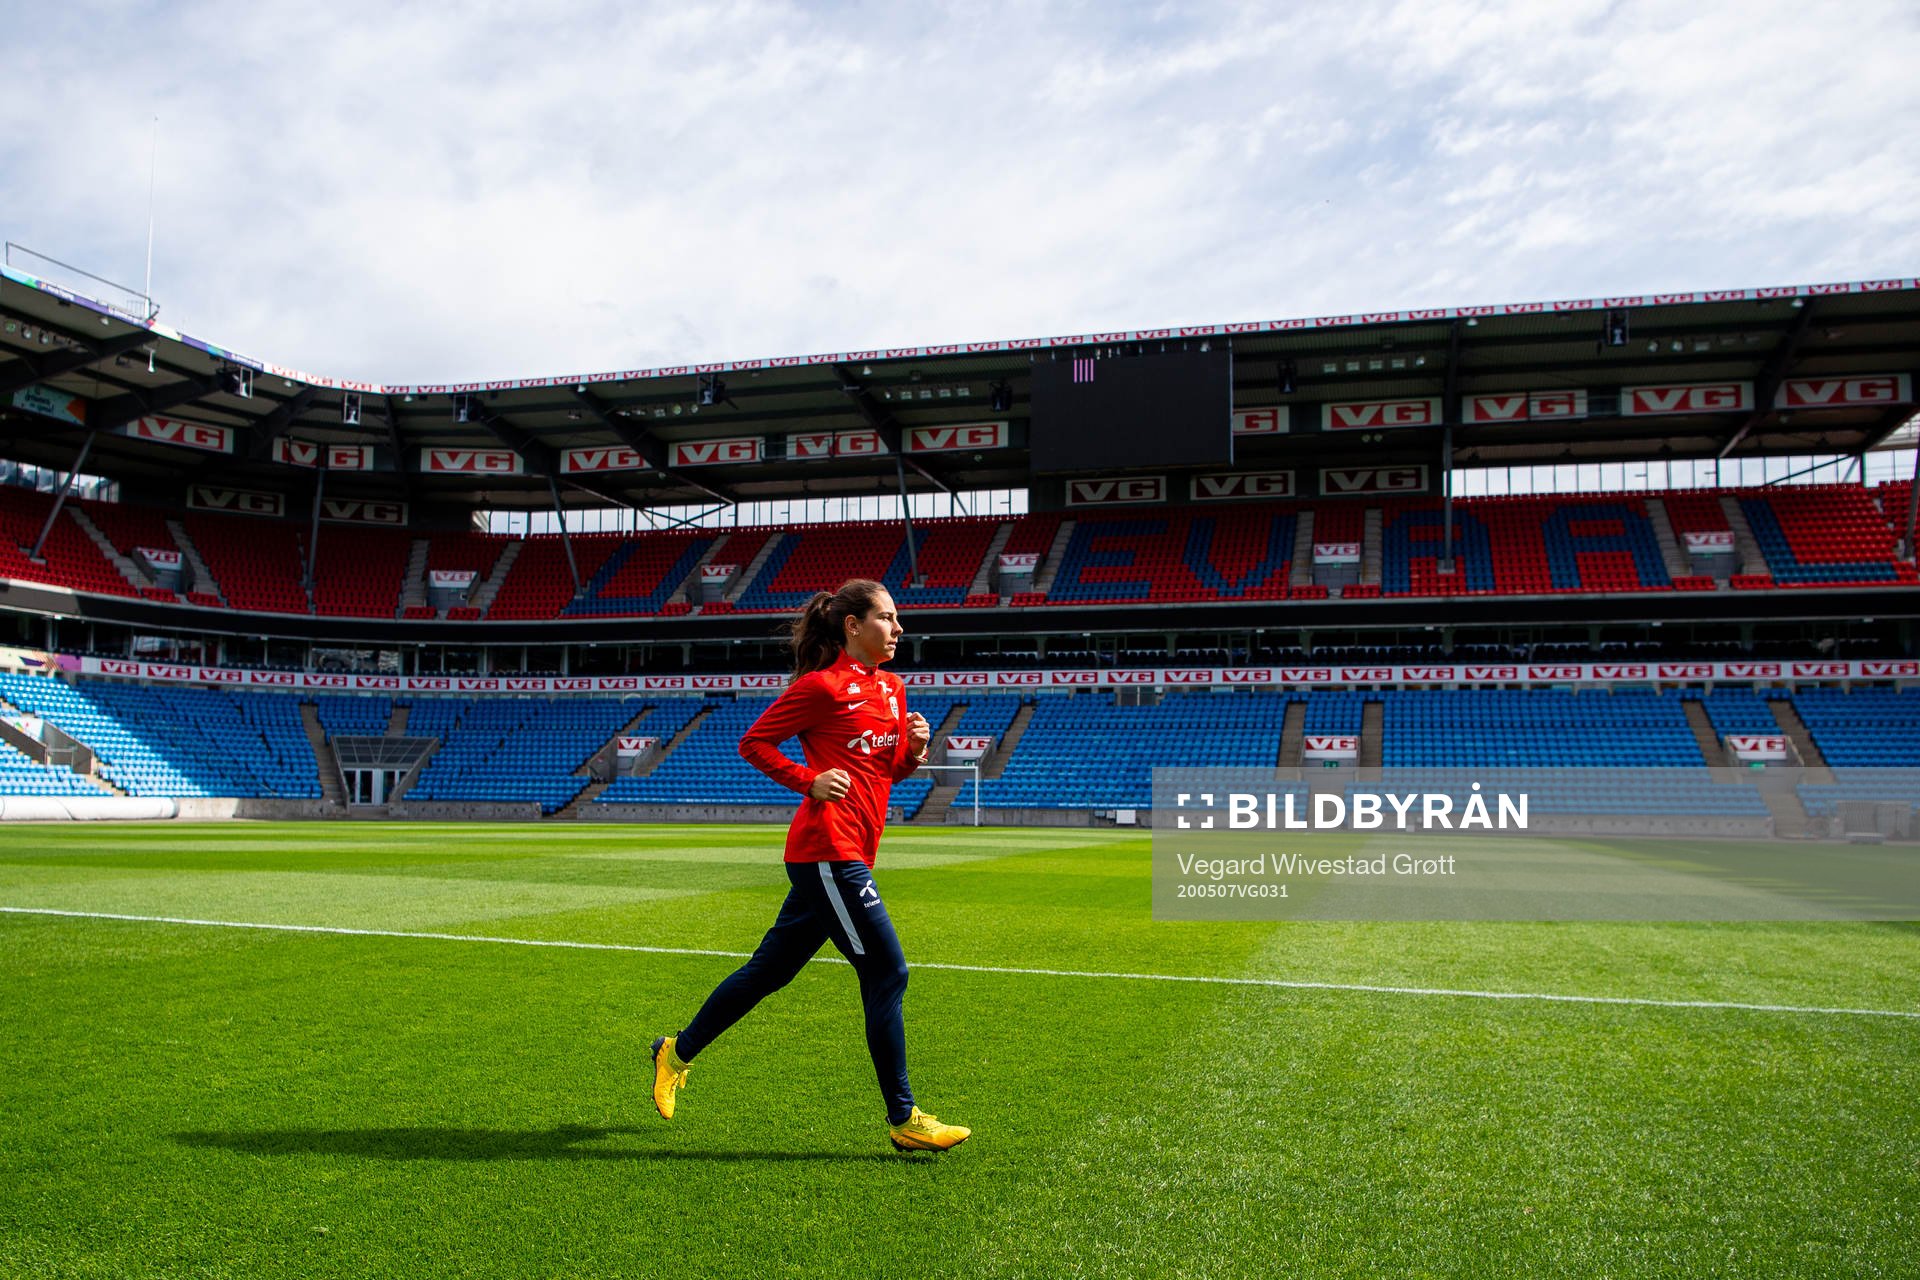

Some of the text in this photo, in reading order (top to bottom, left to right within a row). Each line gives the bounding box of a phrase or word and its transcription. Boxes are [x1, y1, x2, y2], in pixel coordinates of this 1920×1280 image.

[343, 380, 371, 391] VG
[384, 386, 408, 394] VG
[419, 386, 445, 394] VG
[455, 384, 477, 392] VG
[487, 382, 511, 390] VG
[521, 379, 545, 387] VG
[555, 376, 580, 384] VG
[590, 373, 615, 381] VG
[625, 371, 650, 379] VG
[660, 366, 686, 376] VG
[697, 364, 723, 373] VG
[734, 360, 761, 369] VG
[772, 357, 798, 366] VG
[809, 354, 837, 363] VG
[848, 351, 876, 360] VG
[887, 349, 916, 358] VG
[928, 346, 957, 355] VG
[968, 343, 999, 352] VG
[1009, 340, 1040, 349] VG
[1051, 337, 1083, 346] VG
[1095, 333, 1125, 342] VG
[1137, 330, 1170, 339] VG
[1181, 327, 1214, 336] VG
[1226, 323, 1259, 332] VG
[1271, 319, 1304, 329] VG
[1317, 316, 1351, 325] VG
[1363, 313, 1398, 322] VG
[1410, 310, 1445, 319] VG
[1458, 307, 1493, 316] VG
[1507, 303, 1541, 313] VG
[1556, 301, 1591, 310] VG
[1605, 298, 1641, 308] VG
[1656, 295, 1692, 305] VG
[1706, 291, 1743, 302] VG
[1758, 288, 1795, 298] VG
[1810, 285, 1848, 294] VG
[1863, 281, 1901, 291] VG
[1635, 387, 1738, 412] VG
[1790, 378, 1896, 403] VG
[1335, 402, 1429, 426] VG
[1477, 394, 1572, 419] VG
[1233, 410, 1273, 432] G
[143, 417, 219, 448] VG
[915, 426, 995, 449] VG
[290, 441, 360, 468] VG
[679, 442, 752, 464] VG
[798, 433, 878, 456] VG
[434, 452, 510, 471] VG
[571, 449, 642, 470] VG
[1201, 472, 1293, 496] VG
[1330, 467, 1424, 492] VG
[199, 488, 275, 512] VG
[1076, 481, 1155, 501] VG
[324, 500, 397, 522] VG
[1687, 533, 1730, 545] VG
[142, 551, 177, 563] VG
[1001, 556, 1038, 566] VG
[1316, 545, 1356, 556] VG
[436, 571, 472, 582] VG
[703, 566, 734, 577] VG
[102, 661, 138, 675] VG
[149, 665, 190, 678] VG
[201, 669, 241, 682] VG
[253, 672, 294, 684] VG
[305, 675, 346, 687] VG
[358, 677, 398, 689] VG
[409, 678, 449, 689] VG
[460, 679, 498, 689] VG
[508, 679, 544, 689] VG
[555, 679, 590, 689] VG
[600, 678, 636, 689] VG
[647, 677, 683, 688] VG
[694, 677, 731, 687] VG
[742, 676, 779, 687] VG
[945, 673, 987, 685] VG
[999, 672, 1041, 684] VG
[1054, 672, 1097, 684] VG
[1110, 671, 1153, 683] VG
[1167, 670, 1211, 682] VG
[1224, 670, 1270, 682] VG
[1283, 670, 1329, 681] VG
[1344, 668, 1391, 680] VG
[1405, 668, 1453, 680] VG
[1467, 667, 1516, 679] VG
[1531, 666, 1580, 679] VG
[1595, 665, 1646, 678] VG
[1660, 665, 1712, 678] VG
[1727, 664, 1780, 677] VG
[1795, 664, 1848, 676] VG
[1864, 662, 1917, 675] VG
[621, 738, 653, 749] VG
[950, 737, 990, 750] VG
[1308, 738, 1356, 750] VG
[1732, 737, 1783, 751] VG
